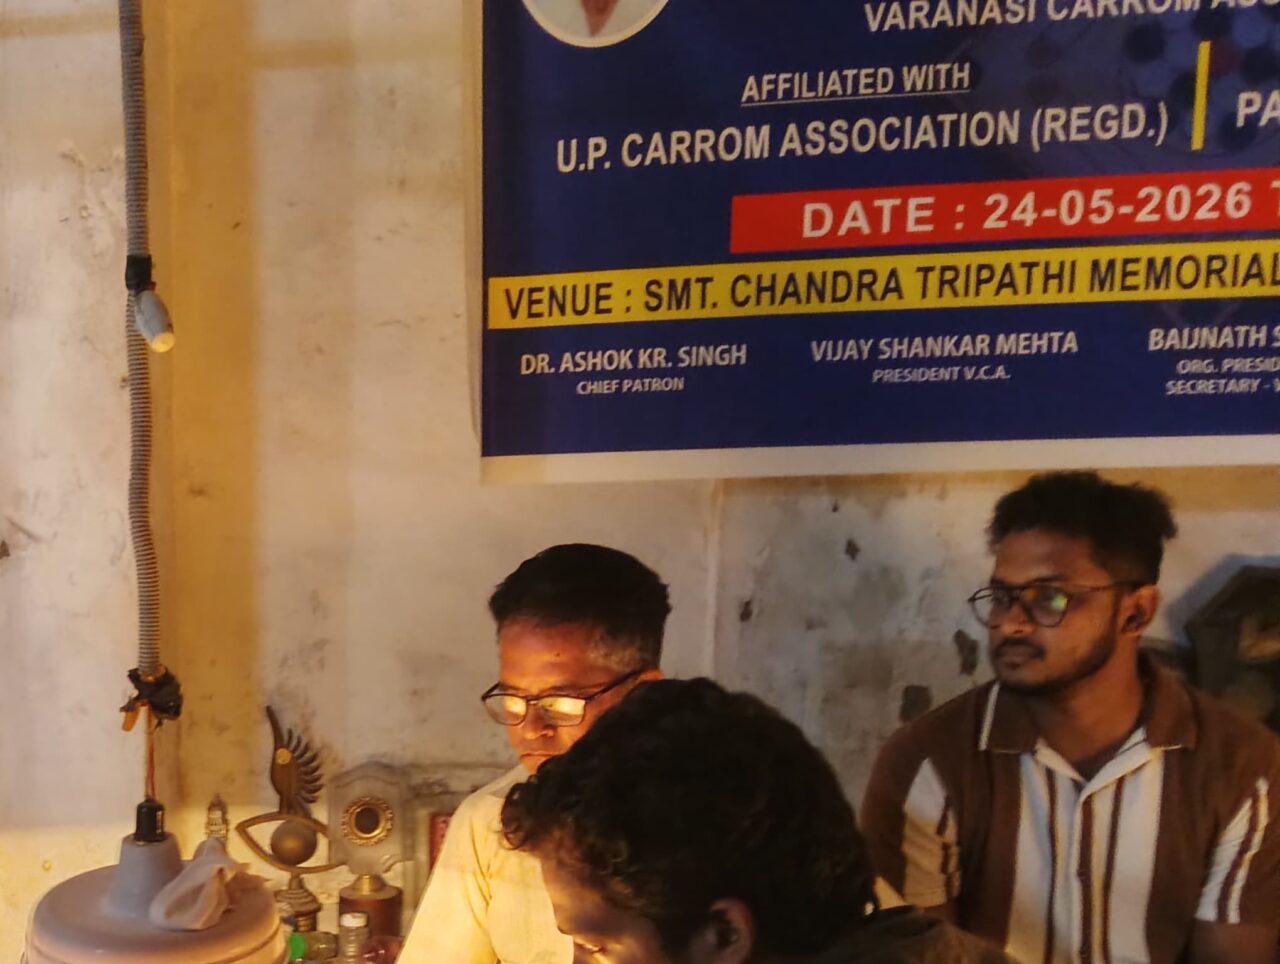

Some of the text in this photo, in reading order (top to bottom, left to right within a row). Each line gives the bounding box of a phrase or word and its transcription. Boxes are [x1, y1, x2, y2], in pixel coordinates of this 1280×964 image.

[865, 0, 1036, 32] VARANASI
[741, 62, 970, 103] AFFILIATED WITH
[556, 101, 1168, 173] U.P. CARROM ASSOCIATION (REGD.)
[802, 197, 936, 238] DATE
[983, 181, 1252, 230] 24-05-2026
[504, 282, 614, 320] VENUE
[644, 277, 718, 312] SMT.
[731, 266, 904, 308] CHANDRA
[916, 259, 1078, 300] TRIPATHI
[1089, 251, 1280, 294] MEMORIAL
[520, 344, 748, 376] DR. ASHOK KR. SINGH
[811, 330, 1080, 362] VIJAY SHANKAR MEHTA
[872, 366, 961, 384] PRESIDENT
[1176, 359, 1218, 375] ORG.
[576, 376, 686, 395] CHIEF PATRON
[1165, 378, 1261, 396] SECRETARY
